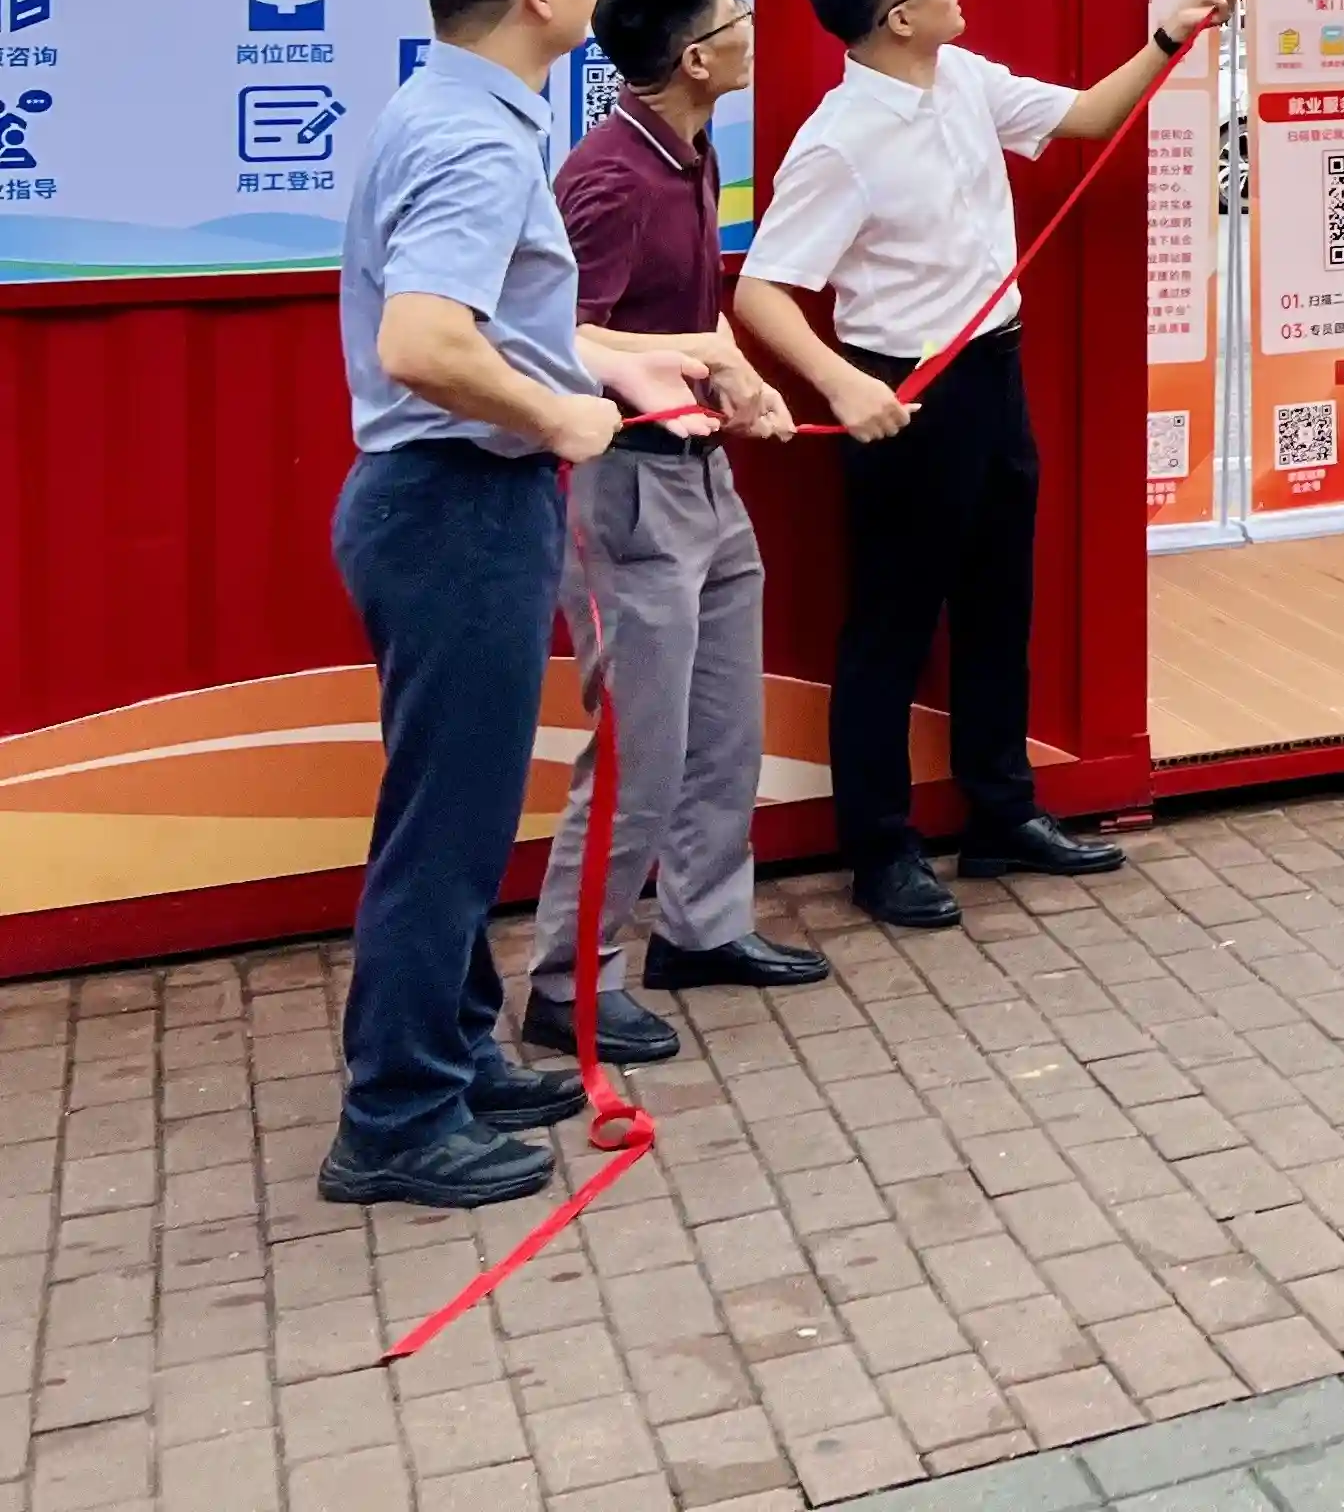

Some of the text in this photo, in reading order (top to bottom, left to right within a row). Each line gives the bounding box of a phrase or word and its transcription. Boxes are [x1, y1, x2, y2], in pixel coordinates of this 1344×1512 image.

[0, 45, 58, 68] 咨询
[236, 43, 335, 65] 岗位匹配
[0, 178, 58, 201] 指导
[236, 171, 335, 193] 用工登记
